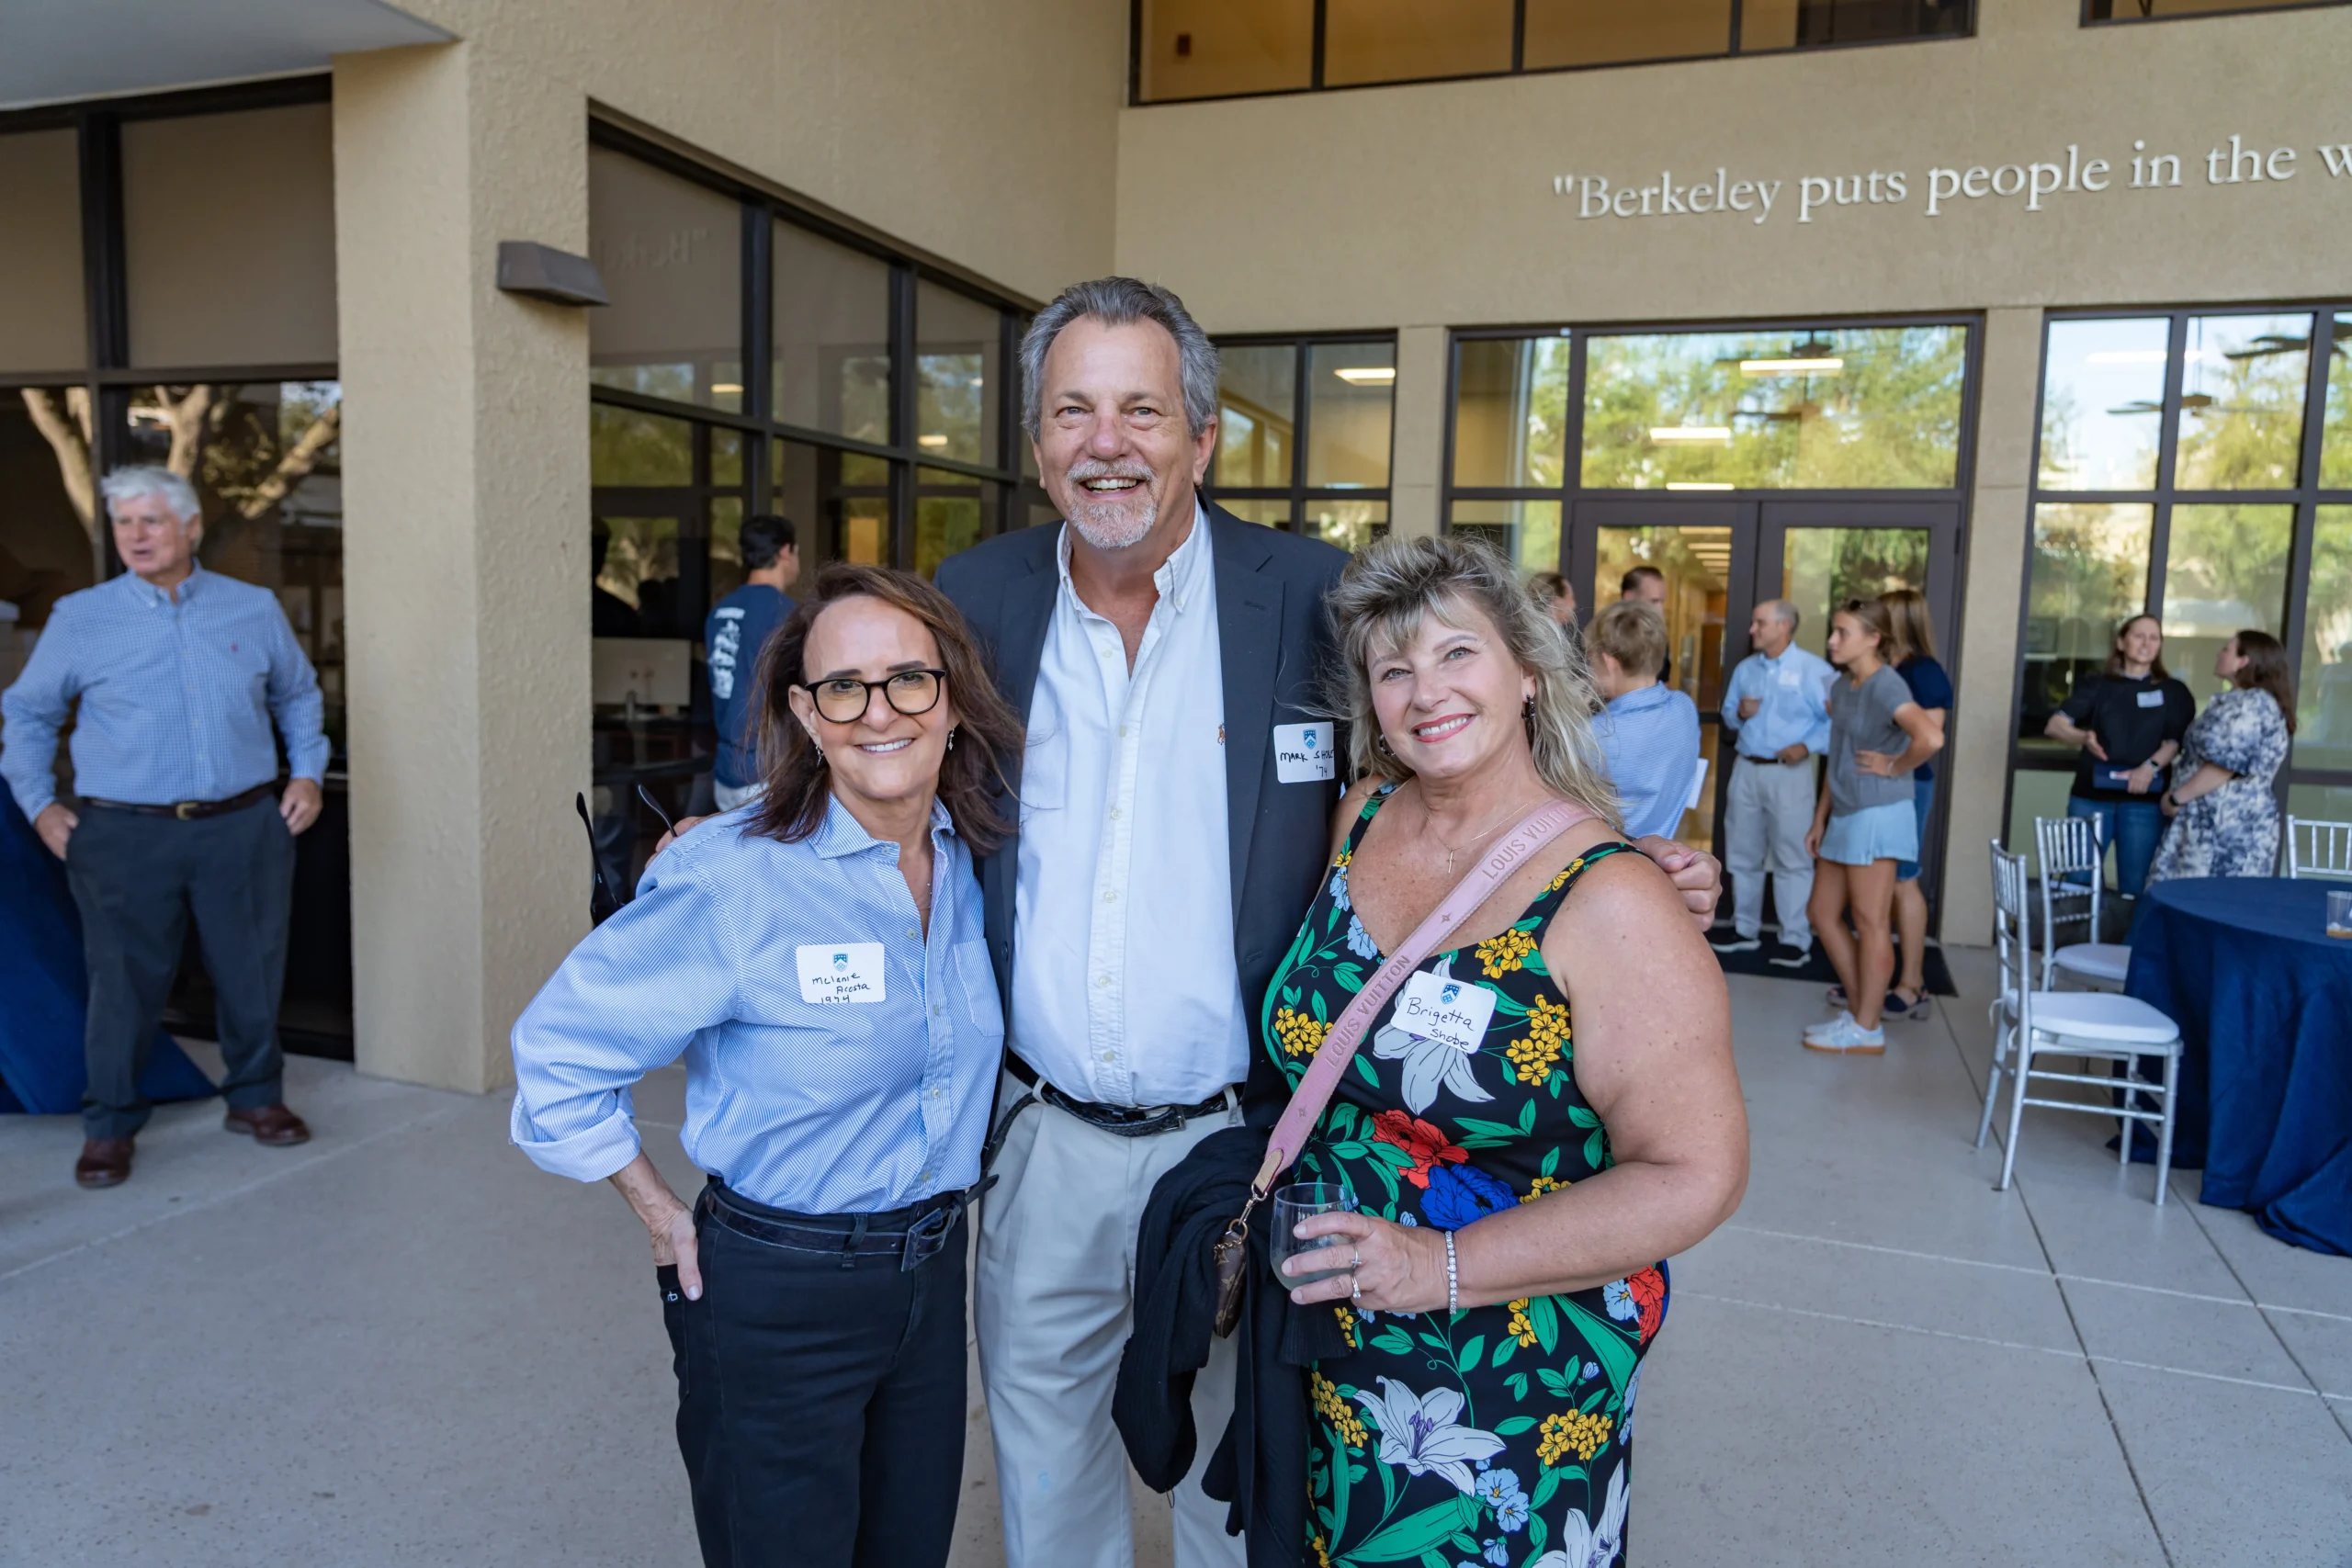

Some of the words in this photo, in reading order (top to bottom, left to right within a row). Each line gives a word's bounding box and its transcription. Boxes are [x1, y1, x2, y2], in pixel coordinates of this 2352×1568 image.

[1553, 167, 1781, 225] "Berkeley
[1797, 169, 1909, 223] puts
[1924, 143, 2111, 217] people
[2127, 139, 2183, 188] in
[2206, 133, 2296, 185] the
[1482, 839, 1526, 880] LOUIS
[1325, 1017, 1361, 1069] LOUIS
[1356, 954, 1411, 1016] VUITTON
[1406, 997, 1475, 1032] Brigetta
